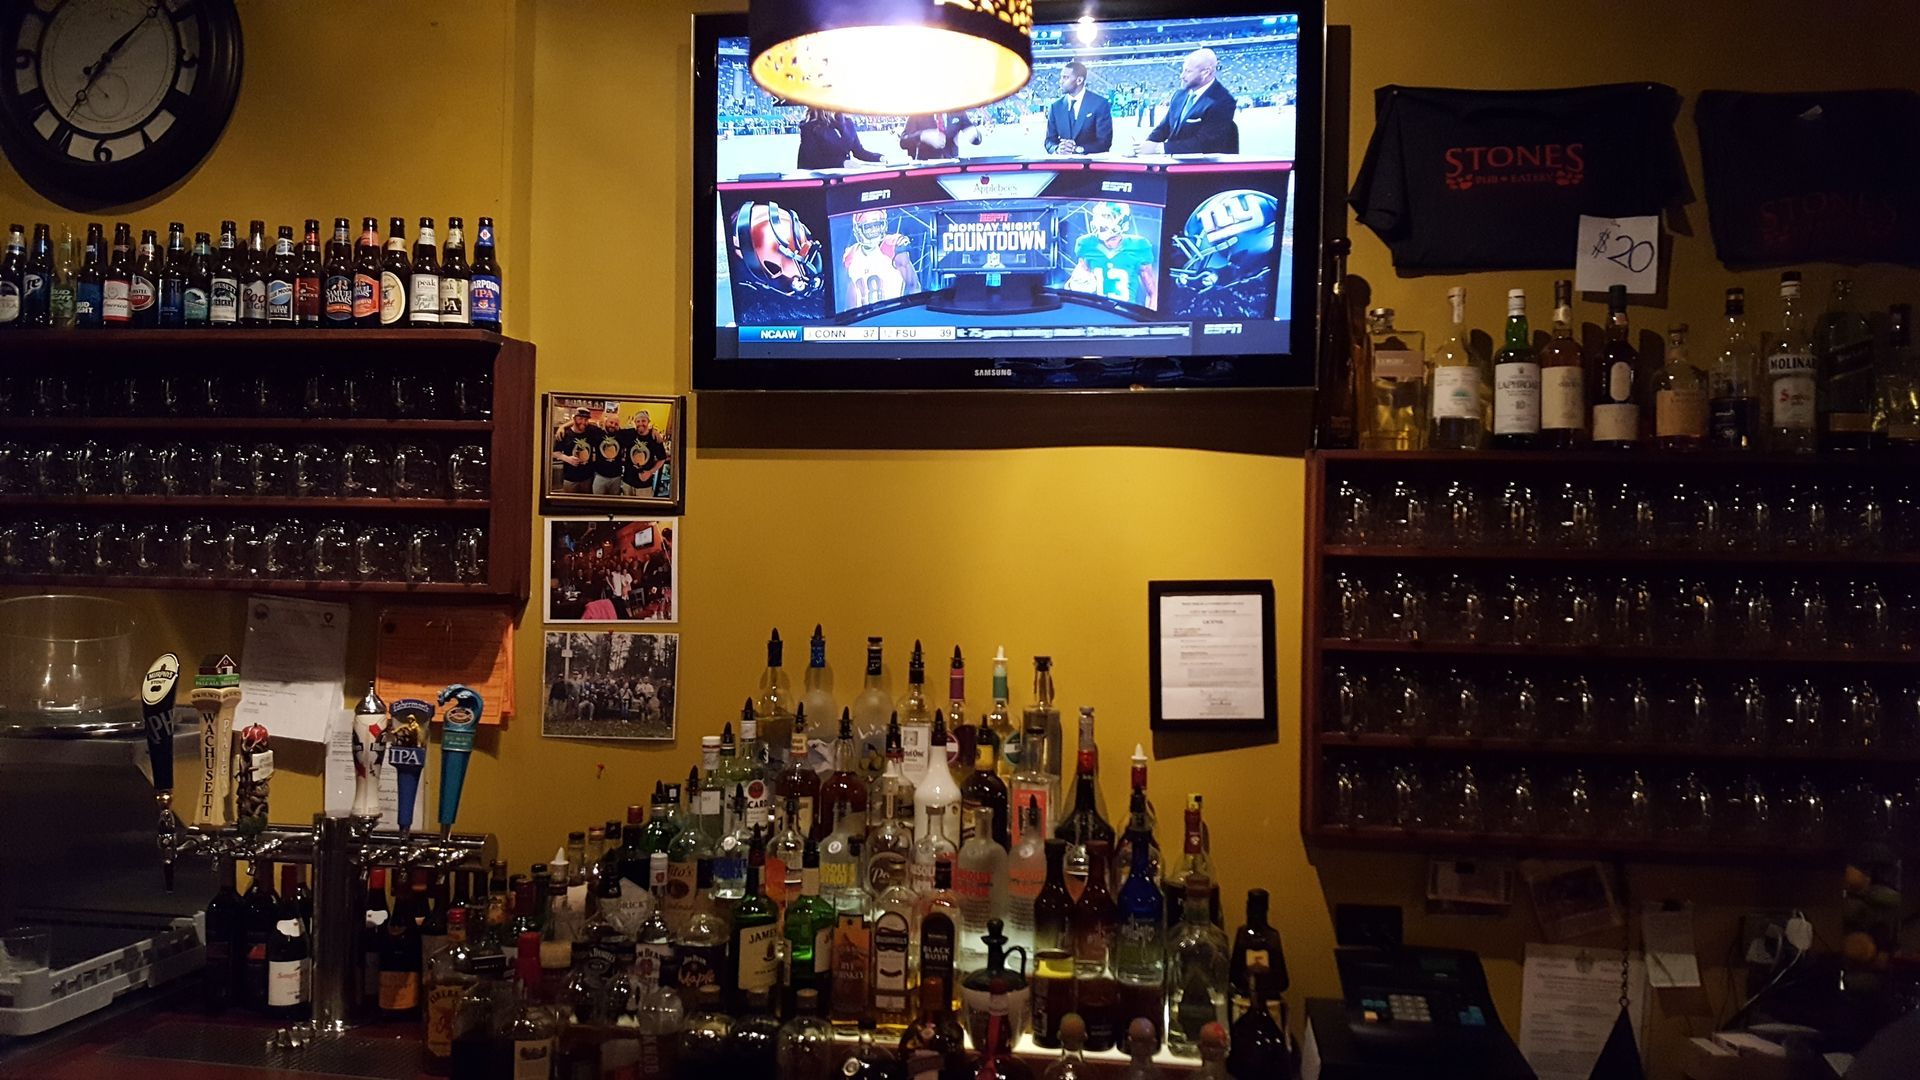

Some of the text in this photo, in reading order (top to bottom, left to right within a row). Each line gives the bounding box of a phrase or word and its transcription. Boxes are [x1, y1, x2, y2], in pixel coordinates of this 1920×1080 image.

[93, 139, 113, 163] 6
[1444, 143, 1585, 178] STONES
[1101, 181, 1133, 192] ESPN
[861, 189, 891, 201] ESPN
[979, 212, 1009, 222] ESPN
[948, 221, 1040, 233] MONDAY NIGHT
[942, 230, 1047, 252] COUNTDOWN
[1591, 228, 1655, 274] $20
[416, 279, 436, 289] peak
[1093, 267, 1131, 302] 13
[242, 287, 267, 303] Coo
[474, 288, 494, 299] IPA
[759, 329, 798, 340] NCAAW
[814, 329, 847, 339] CONN
[863, 329, 875, 338] 37
[895, 329, 917, 338] FSU
[939, 328, 953, 338] 39
[1203, 323, 1243, 335] ESPN
[973, 368, 1013, 377] SAMSUNG
[390, 749, 423, 766] IPA
[202, 711, 217, 818] WACHUSETT
[922, 945, 951, 954] BLACK
[924, 953, 949, 962] BUSH
